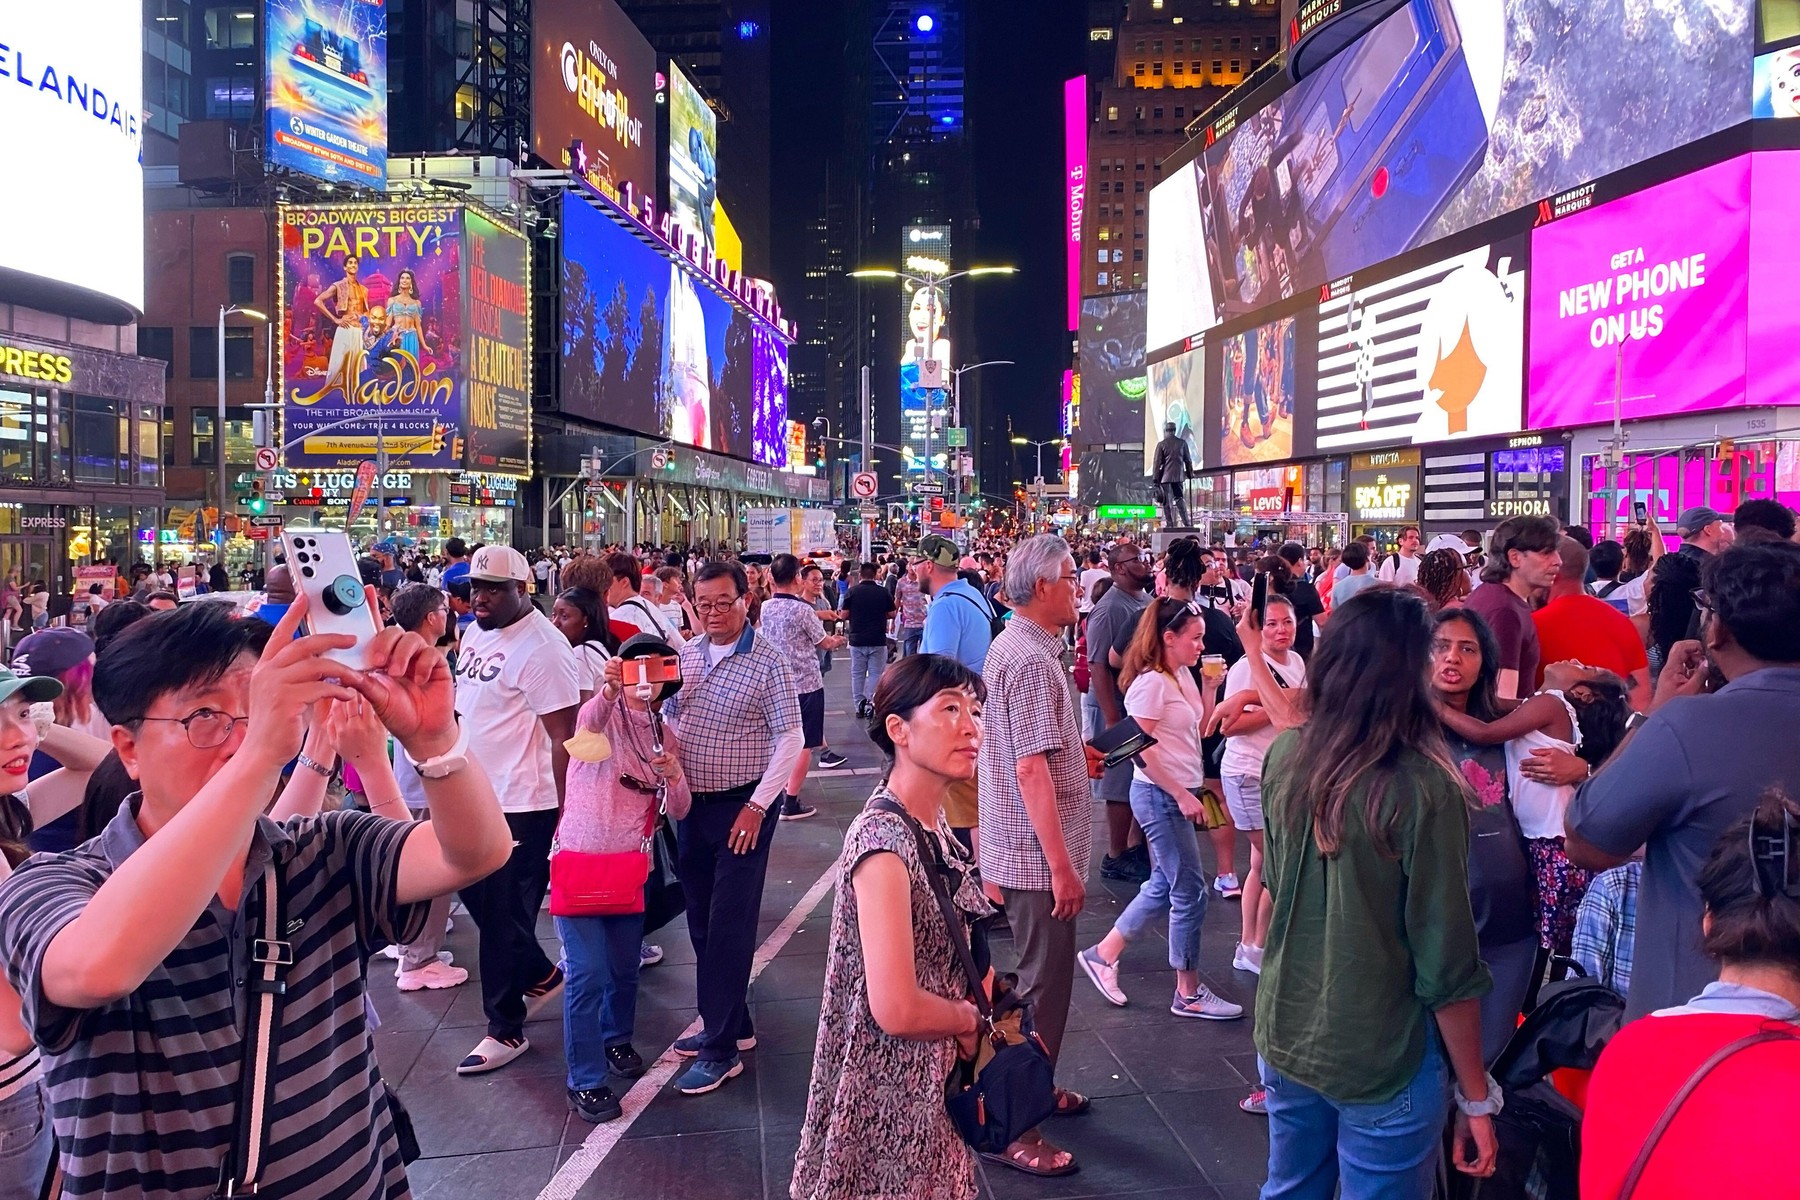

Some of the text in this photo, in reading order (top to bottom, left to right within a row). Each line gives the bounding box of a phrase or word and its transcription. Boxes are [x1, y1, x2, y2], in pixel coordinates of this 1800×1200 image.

[1301, 1, 1340, 33] MARQUIS
[589, 40, 618, 80] ONLY ON
[1215, 106, 1239, 130] MARRIOTT
[1215, 119, 1236, 140] MARQUIS
[282, 135, 313, 152] BROADWAY
[344, 158, 355, 166] AND
[304, 124, 369, 156] WINTER GARDEN THEATRE
[1555, 183, 1597, 206] MARRIOTT
[1555, 196, 1591, 216] MARQUIS
[286, 208, 457, 226] BROADWAY'S BIGGEST
[303, 225, 443, 259] PARTY!
[470, 231, 486, 269] THE
[626, 181, 782, 328] 1540 BROADWAY
[1610, 247, 1645, 270] GET A
[470, 264, 527, 317] NEIL DIAMOND
[1559, 252, 1706, 319] NEW PHONE
[470, 297, 503, 340] MUSICAL
[1590, 304, 1663, 348] ON US
[470, 334, 526, 392] A BEAUTIFUL
[291, 349, 453, 406] Aladdin
[305, 408, 323, 417] THE
[325, 408, 340, 417] HIT
[470, 380, 498, 431] NOISE
[1746, 418, 1767, 429] 1535
[1509, 436, 1542, 448] SEPHORA
[1370, 452, 1399, 465] INVICTA
[314, 474, 412, 489] LUGAGE
[485, 473, 518, 491] LUGGAGE
[746, 467, 767, 490] FOREVER
[322, 489, 338, 497] NY
[1355, 484, 1411, 509] 50% OFF
[1490, 500, 1551, 516] SEPHORA
[21, 517, 66, 528] EXPRESS
[476, 554, 489, 570] NY
[456, 646, 506, 682] D&G
